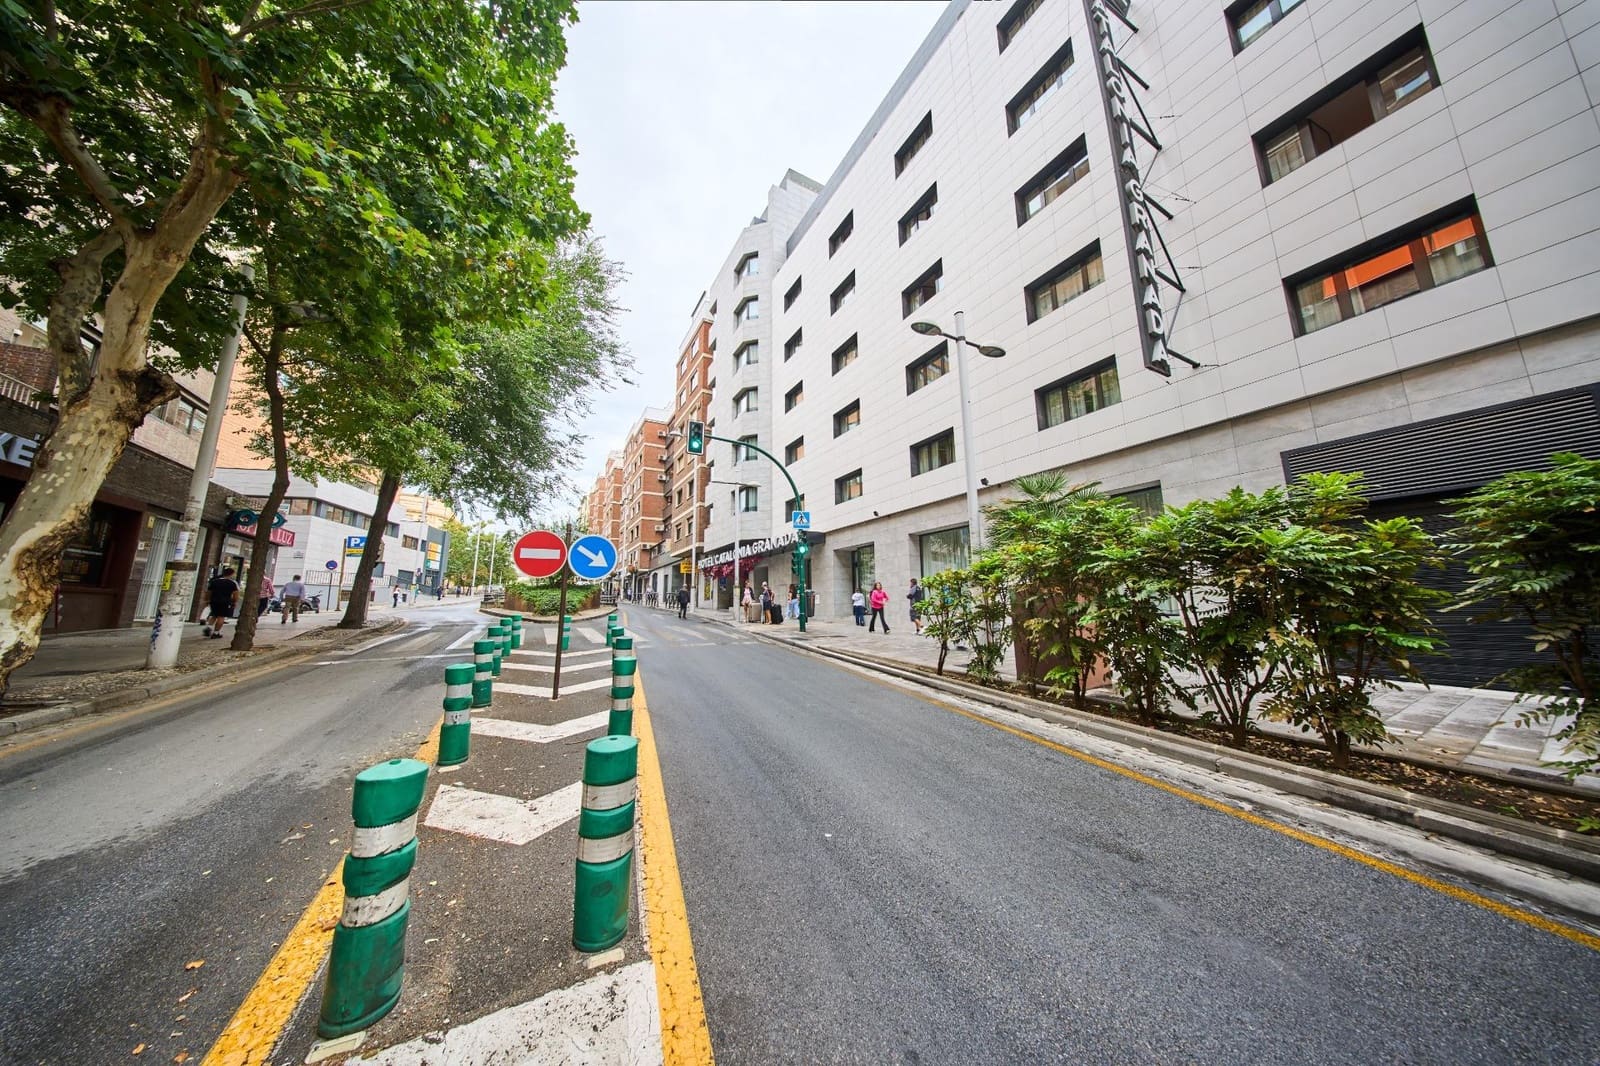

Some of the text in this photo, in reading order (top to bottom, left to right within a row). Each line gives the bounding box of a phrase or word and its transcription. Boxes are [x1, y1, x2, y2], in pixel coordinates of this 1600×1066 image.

[1125, 178, 1169, 366] GRANADA
[276, 528, 293, 545] LUZ
[350, 537, 361, 547] P
[698, 556, 714, 569] HOTEL
[752, 532, 799, 554] GRANADA
